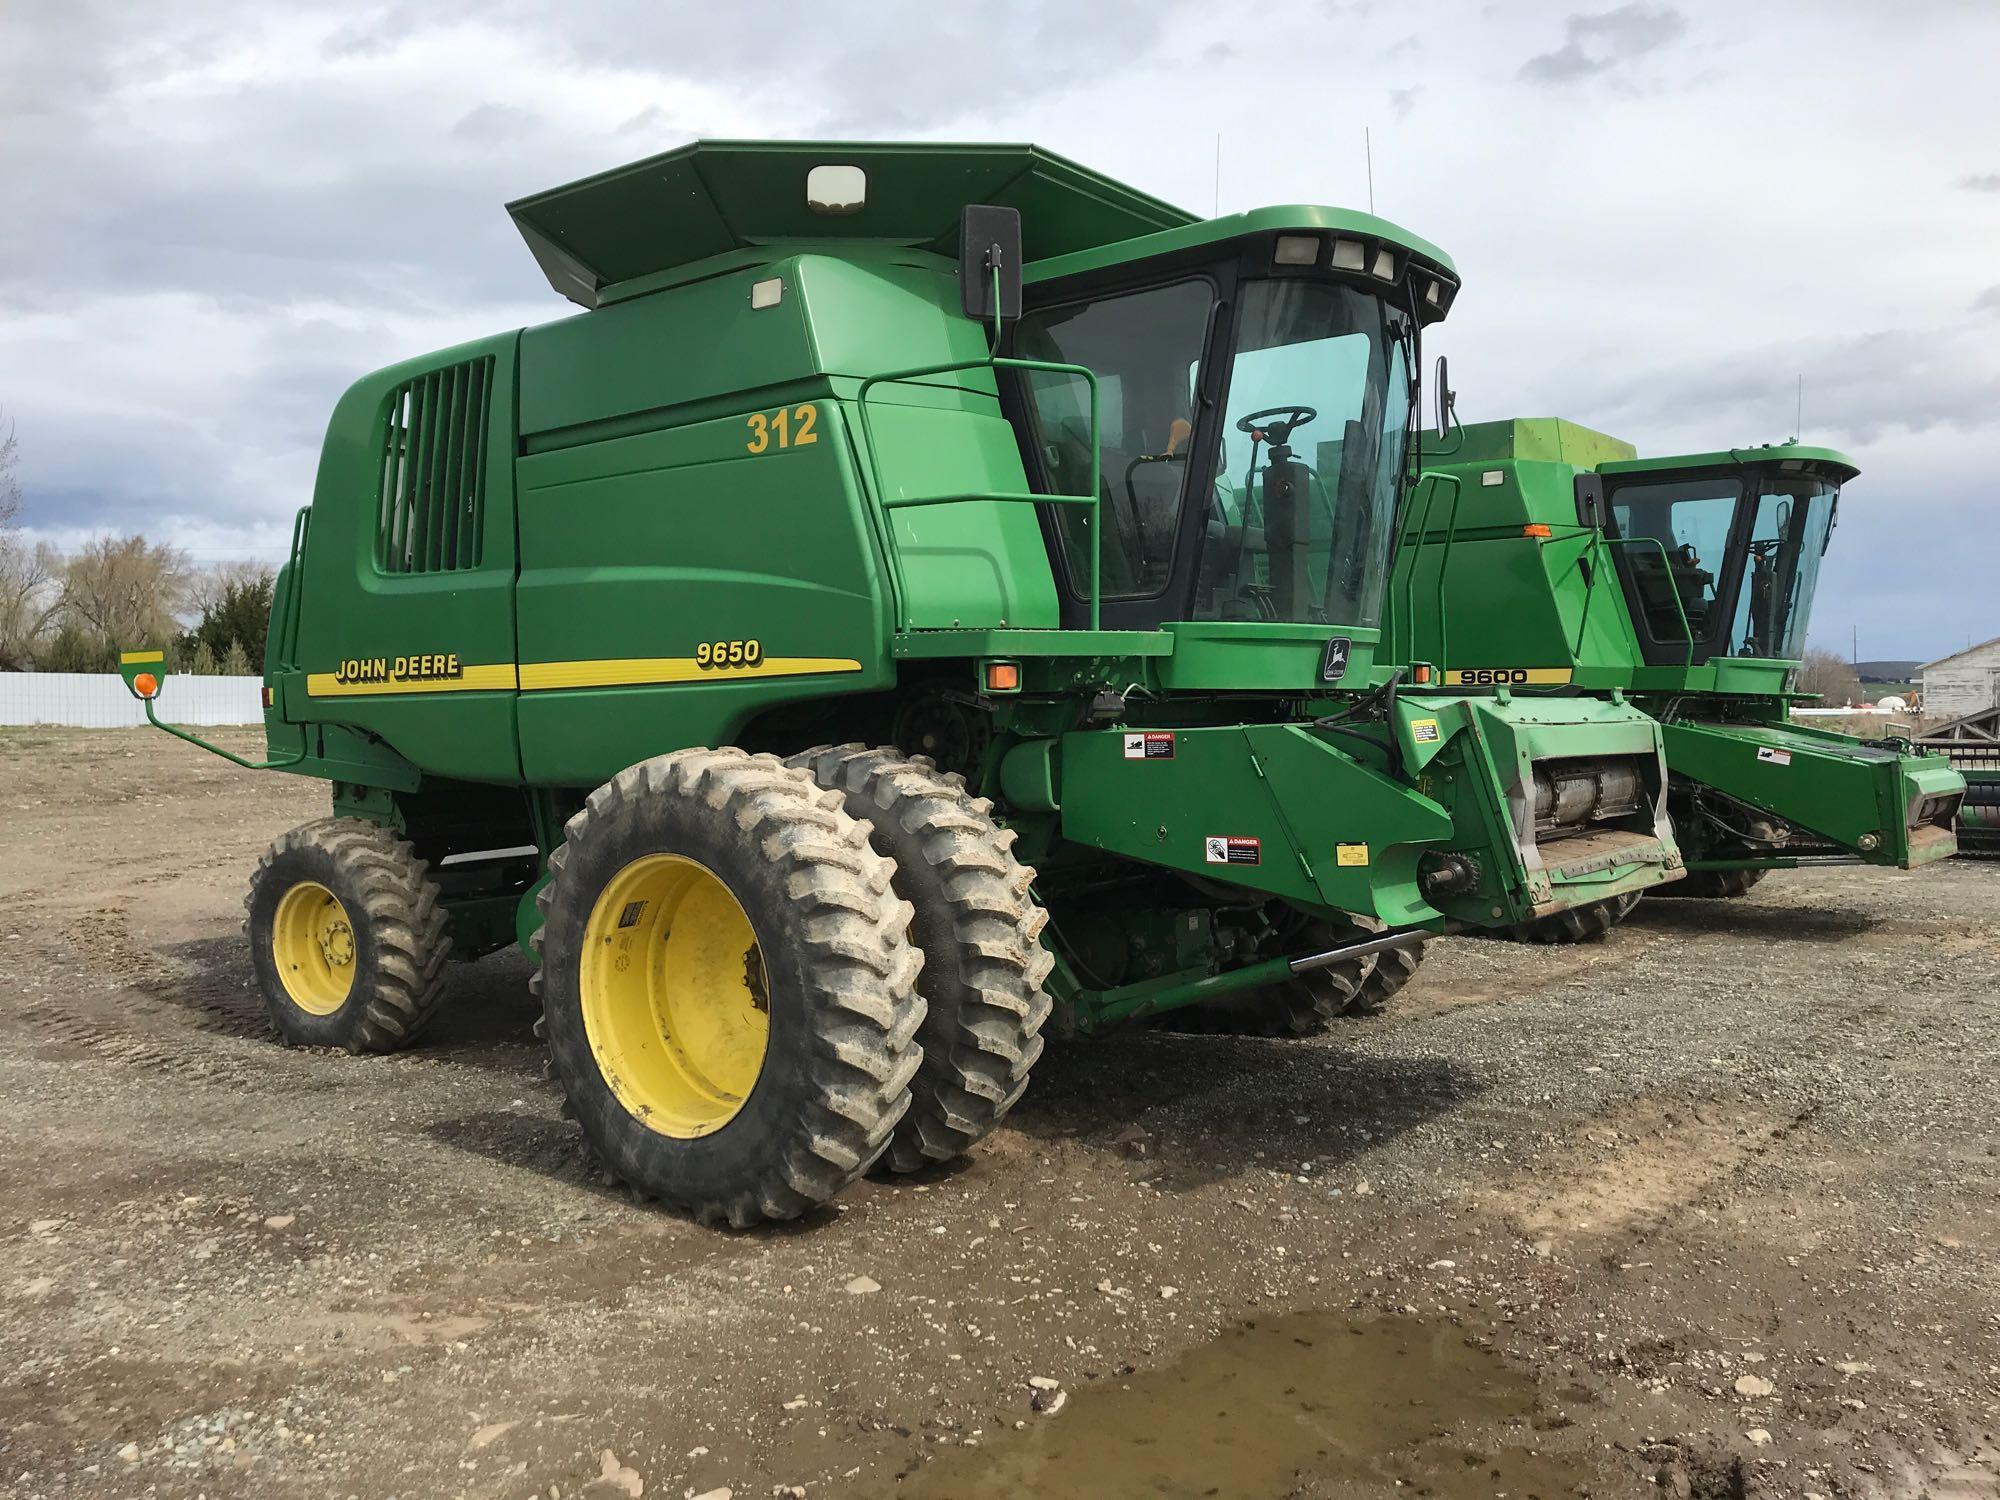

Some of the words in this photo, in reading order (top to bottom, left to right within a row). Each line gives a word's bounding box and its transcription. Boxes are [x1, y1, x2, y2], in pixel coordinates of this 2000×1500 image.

[746, 404, 818, 454] 312
[335, 657, 388, 683] JOHN
[394, 653, 461, 680] DEERE
[696, 639, 762, 668] 9650
[1460, 669, 1528, 684] 9600
